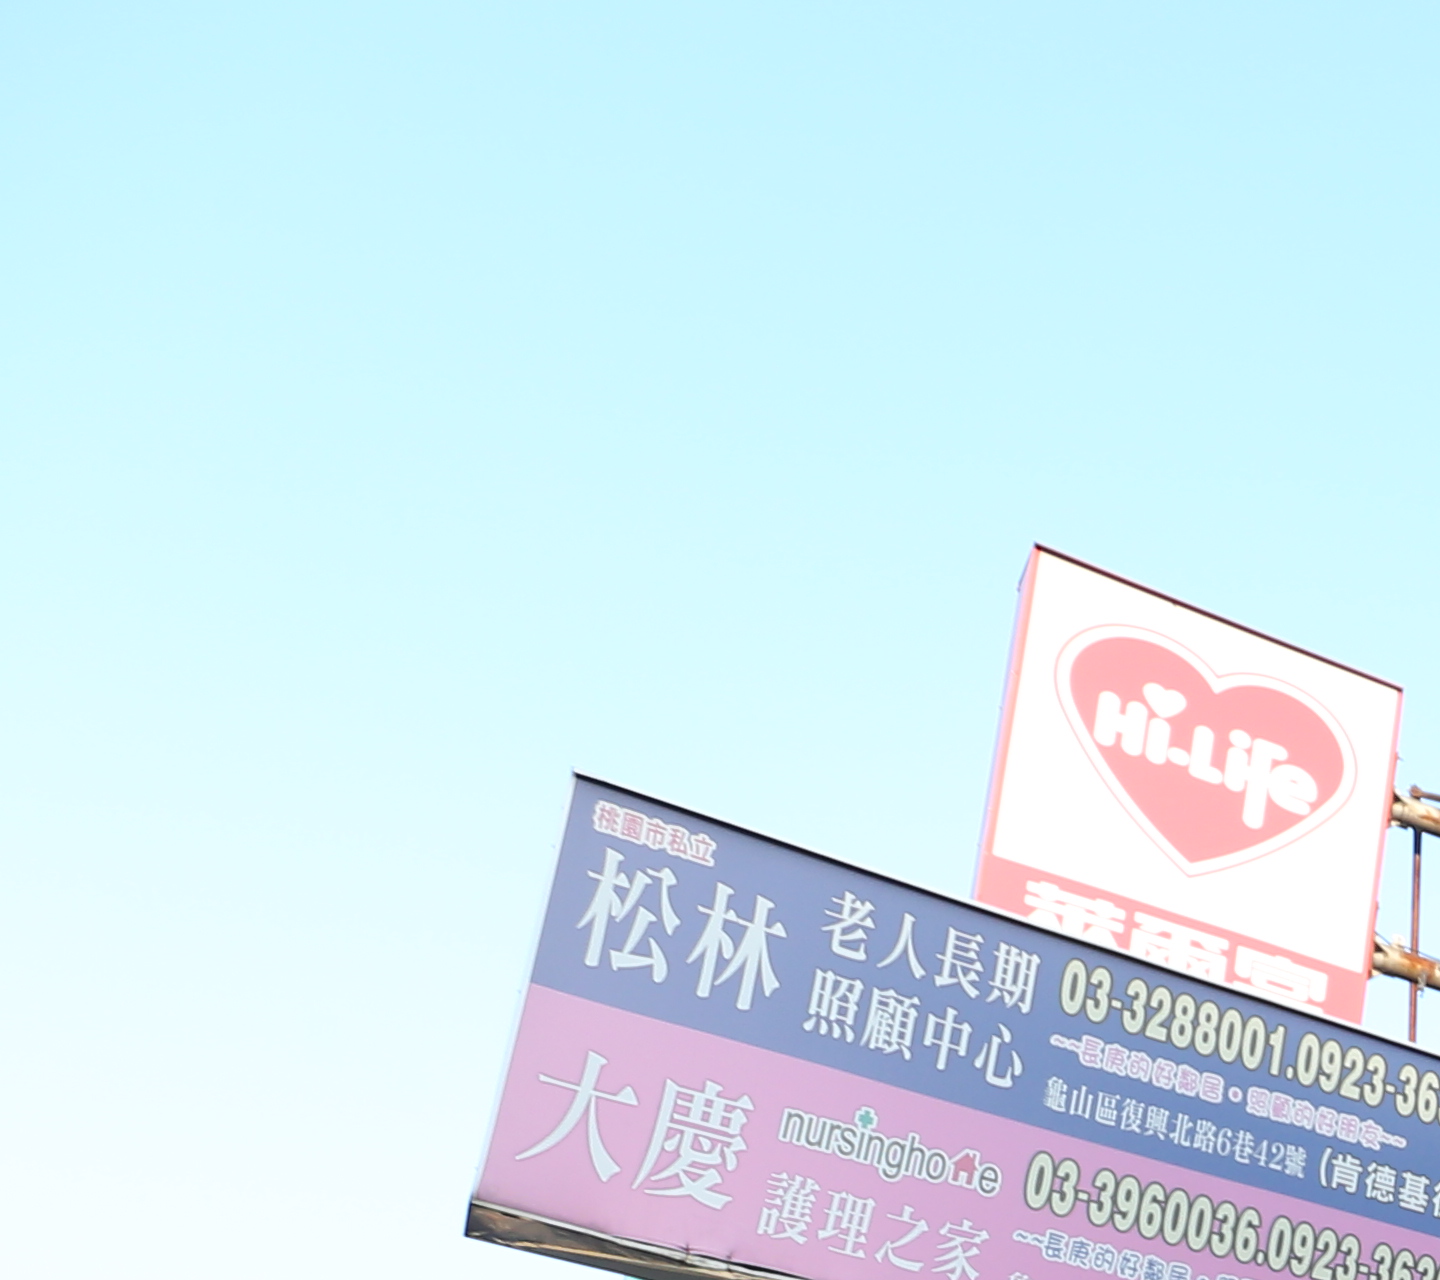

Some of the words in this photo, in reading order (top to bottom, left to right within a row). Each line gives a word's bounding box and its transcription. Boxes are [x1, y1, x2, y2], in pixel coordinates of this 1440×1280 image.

[1092, 682, 1320, 831] Hi-Life
[594, 802, 718, 864] 桃園市私立
[576, 849, 789, 1012] 松林
[820, 891, 1043, 1017] 老人長期
[802, 967, 1025, 1088] 照顧中心
[515, 1050, 751, 1210] 大慶
